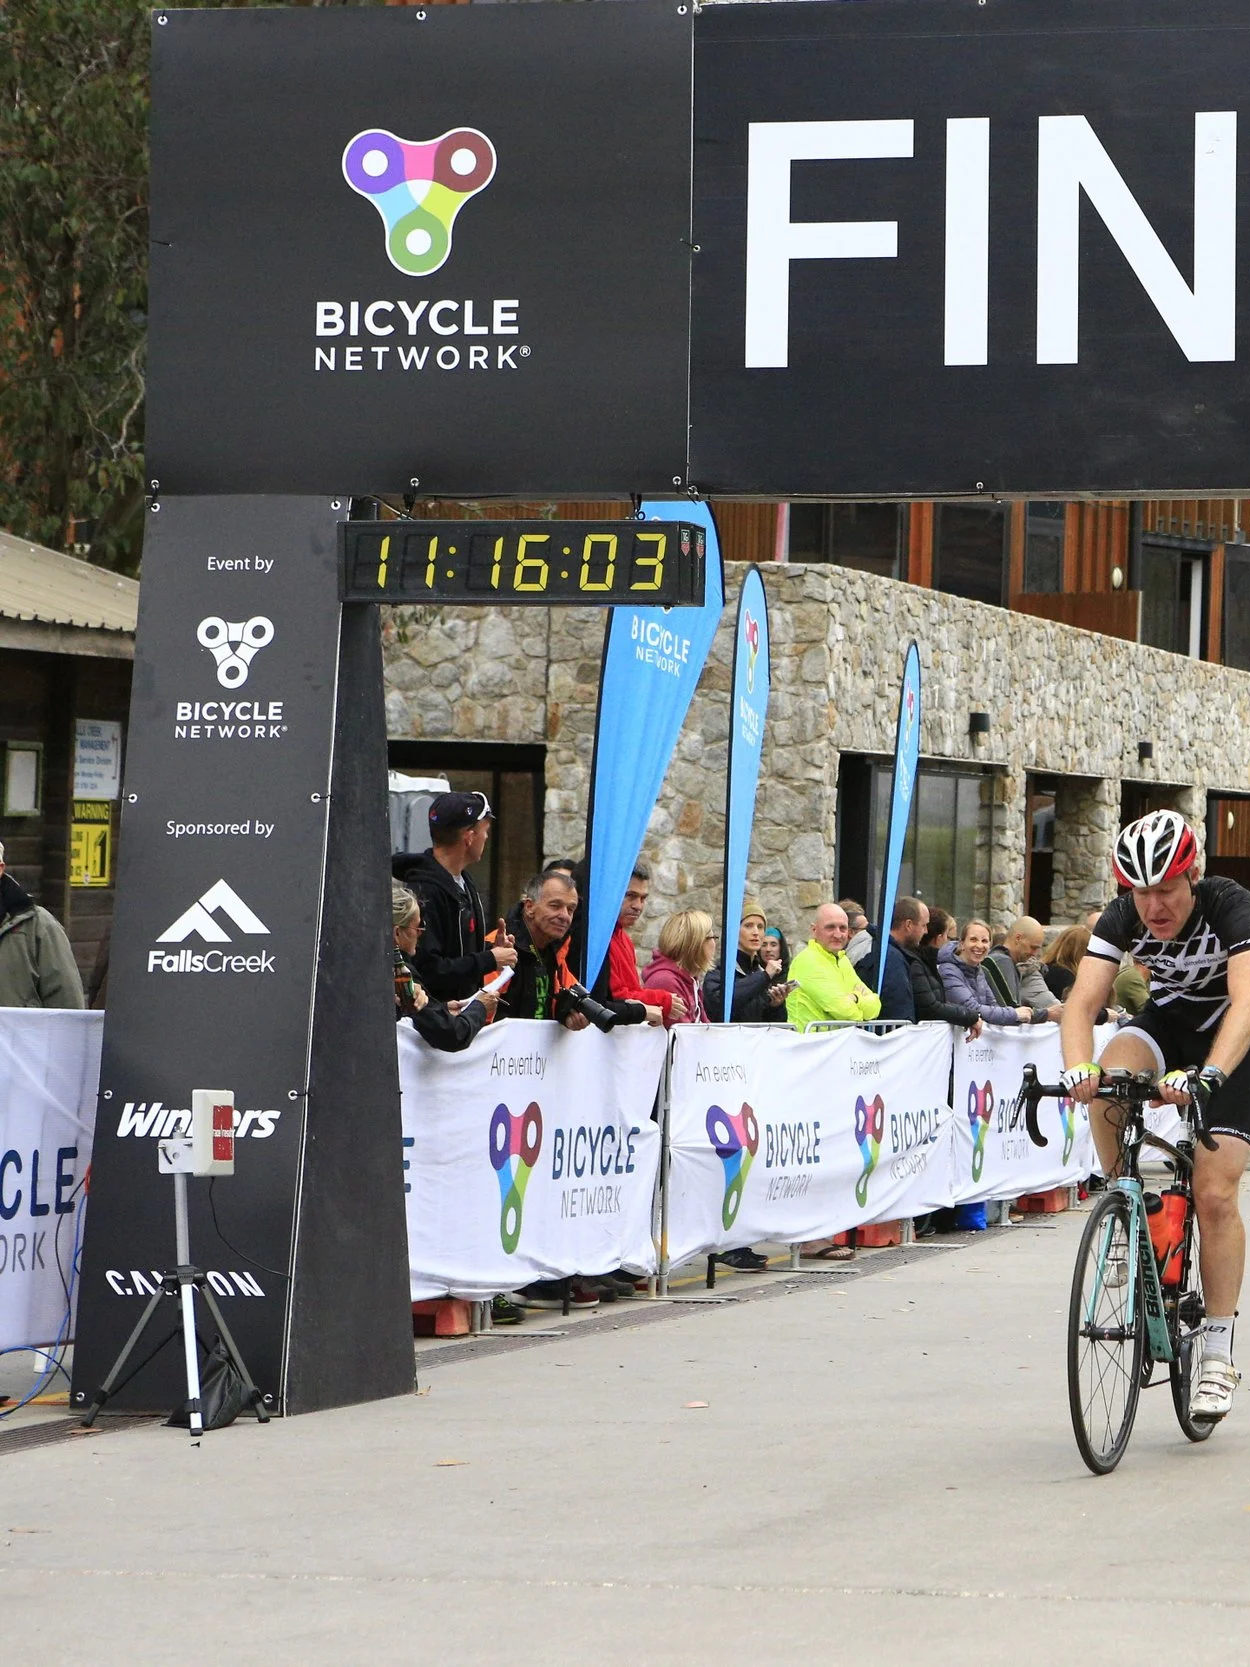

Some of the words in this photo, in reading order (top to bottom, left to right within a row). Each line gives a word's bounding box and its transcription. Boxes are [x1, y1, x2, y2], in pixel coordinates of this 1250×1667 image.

[315, 300, 520, 337] BICYCLE
[207, 556, 250, 571] Event
[254, 556, 274, 573] by
[377, 533, 667, 591] 11:16:03
[631, 614, 691, 664] BICYCLE
[176, 702, 284, 721] BICYCLE
[74, 803, 109, 820] WARNING
[166, 820, 250, 838] Sponsored
[254, 820, 275, 838] by
[147, 950, 276, 973] FallsCreek
[490, 1052, 506, 1077] An
[507, 1053, 533, 1076] event
[535, 1051, 547, 1080] by
[696, 1061, 711, 1082] An
[116, 1102, 281, 1138] Winrs
[891, 1108, 940, 1154] BICYCLE
[552, 1126, 640, 1180] BICYCLE
[766, 1121, 820, 1169] BICYCLE
[561, 1186, 621, 1219] NETWORK
[105, 1269, 266, 1297] CAON
